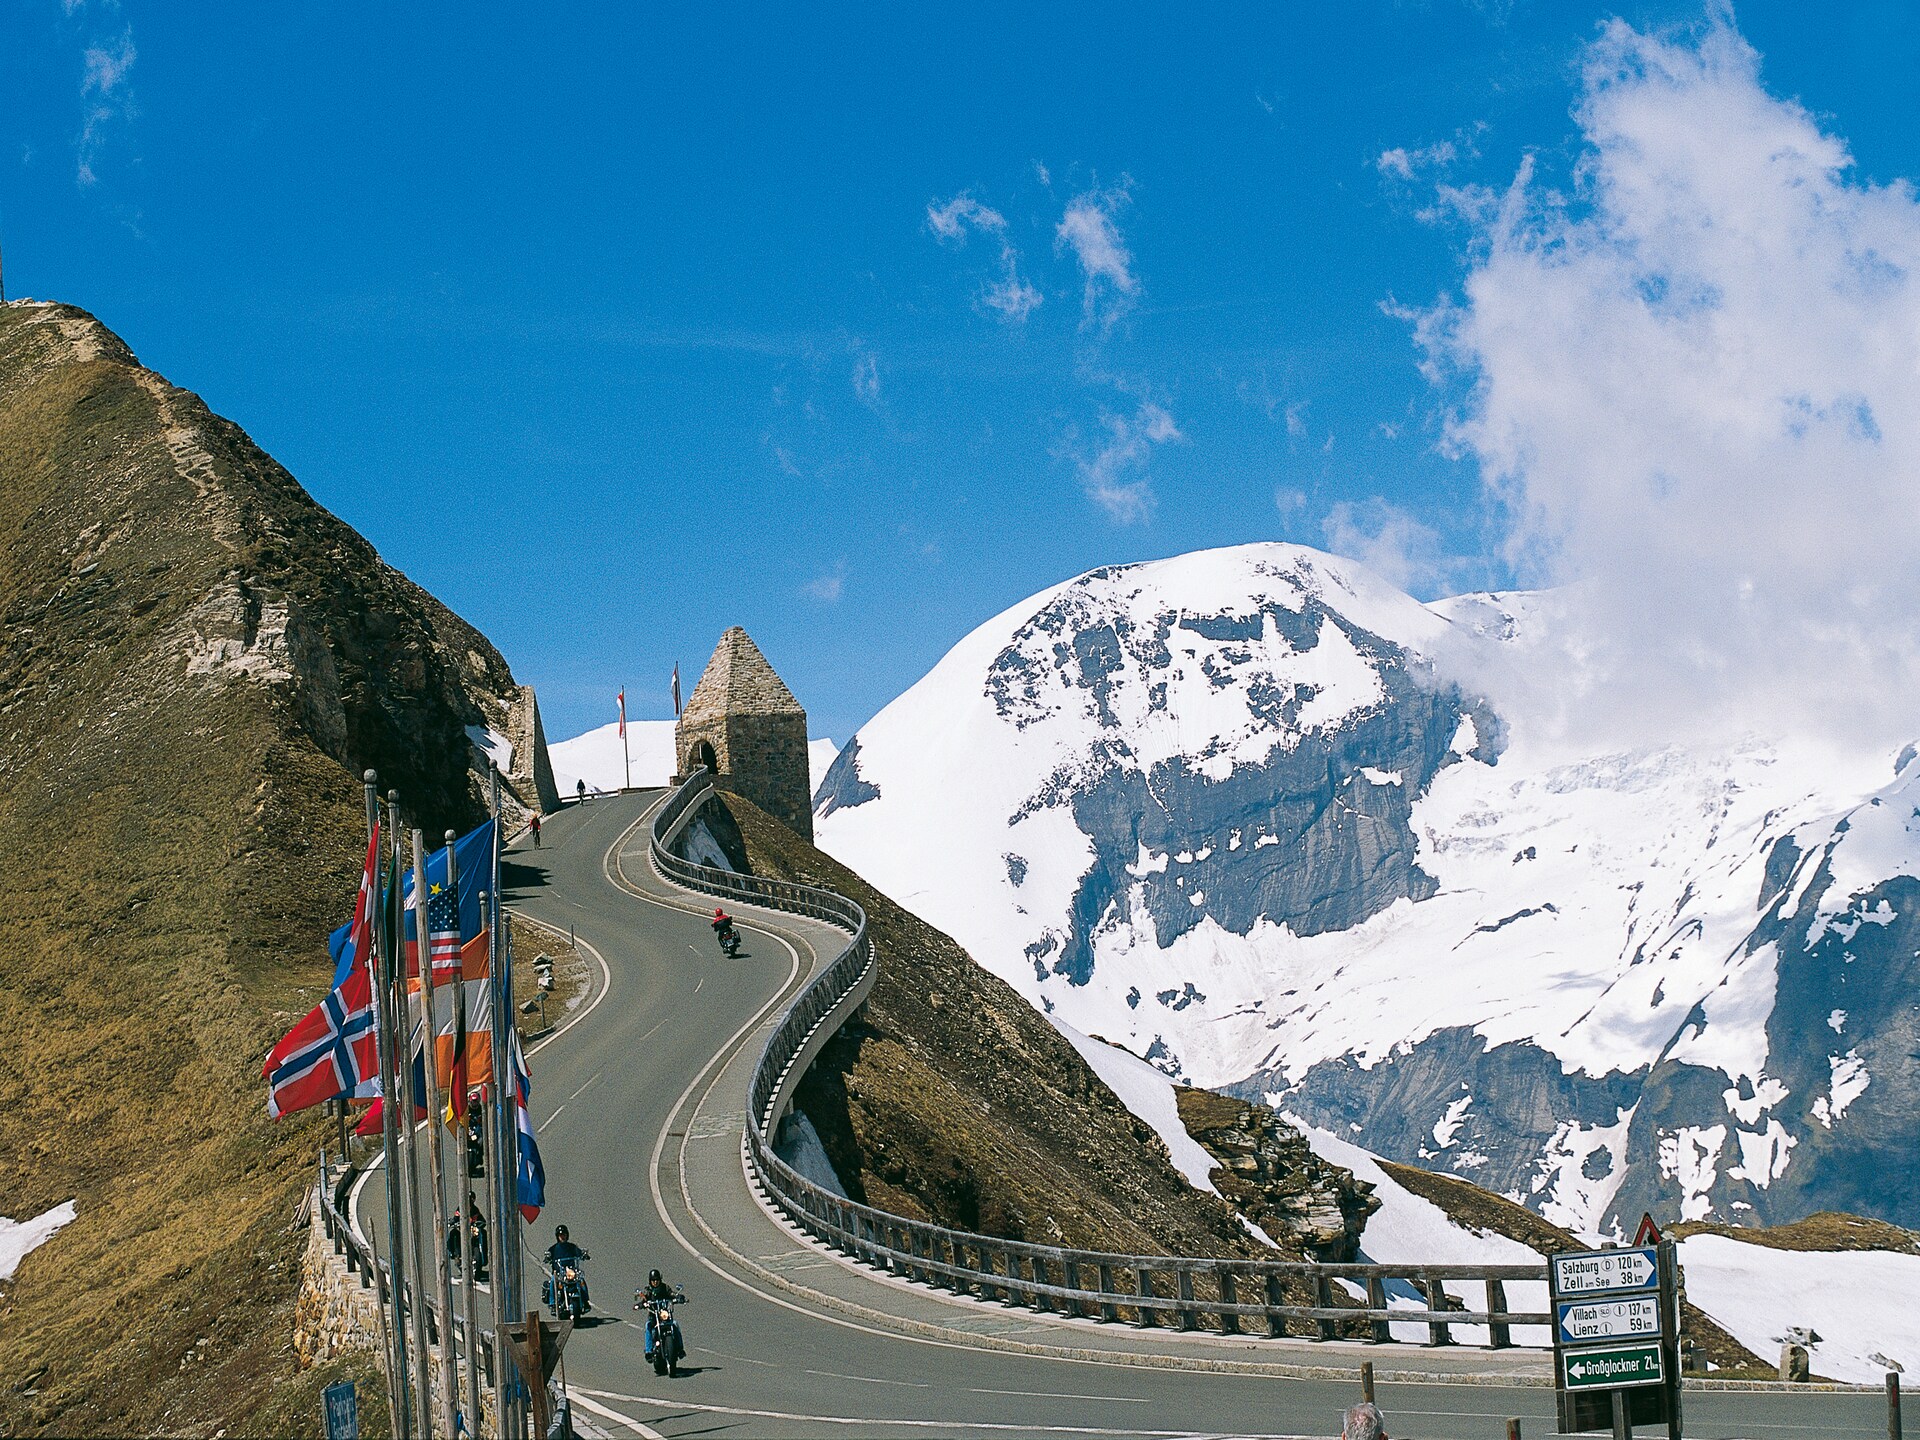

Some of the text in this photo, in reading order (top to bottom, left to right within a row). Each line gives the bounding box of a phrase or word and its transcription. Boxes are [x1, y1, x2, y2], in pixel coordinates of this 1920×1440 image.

[1562, 1261, 1598, 1275] Salzburg
[1617, 1256, 1632, 1269] 120
[1633, 1258, 1642, 1268] km
[1564, 1276, 1583, 1290] Zell
[1595, 1277, 1610, 1287] See
[1620, 1271, 1633, 1285] 38
[1634, 1274, 1643, 1283] km
[1572, 1307, 1597, 1321] Villach
[1628, 1303, 1641, 1316] 137
[1642, 1305, 1652, 1315] km
[1573, 1323, 1599, 1336] Lienz
[1630, 1318, 1642, 1331] 59
[1643, 1320, 1653, 1330] km
[1586, 1358, 1640, 1378] Großglockner
